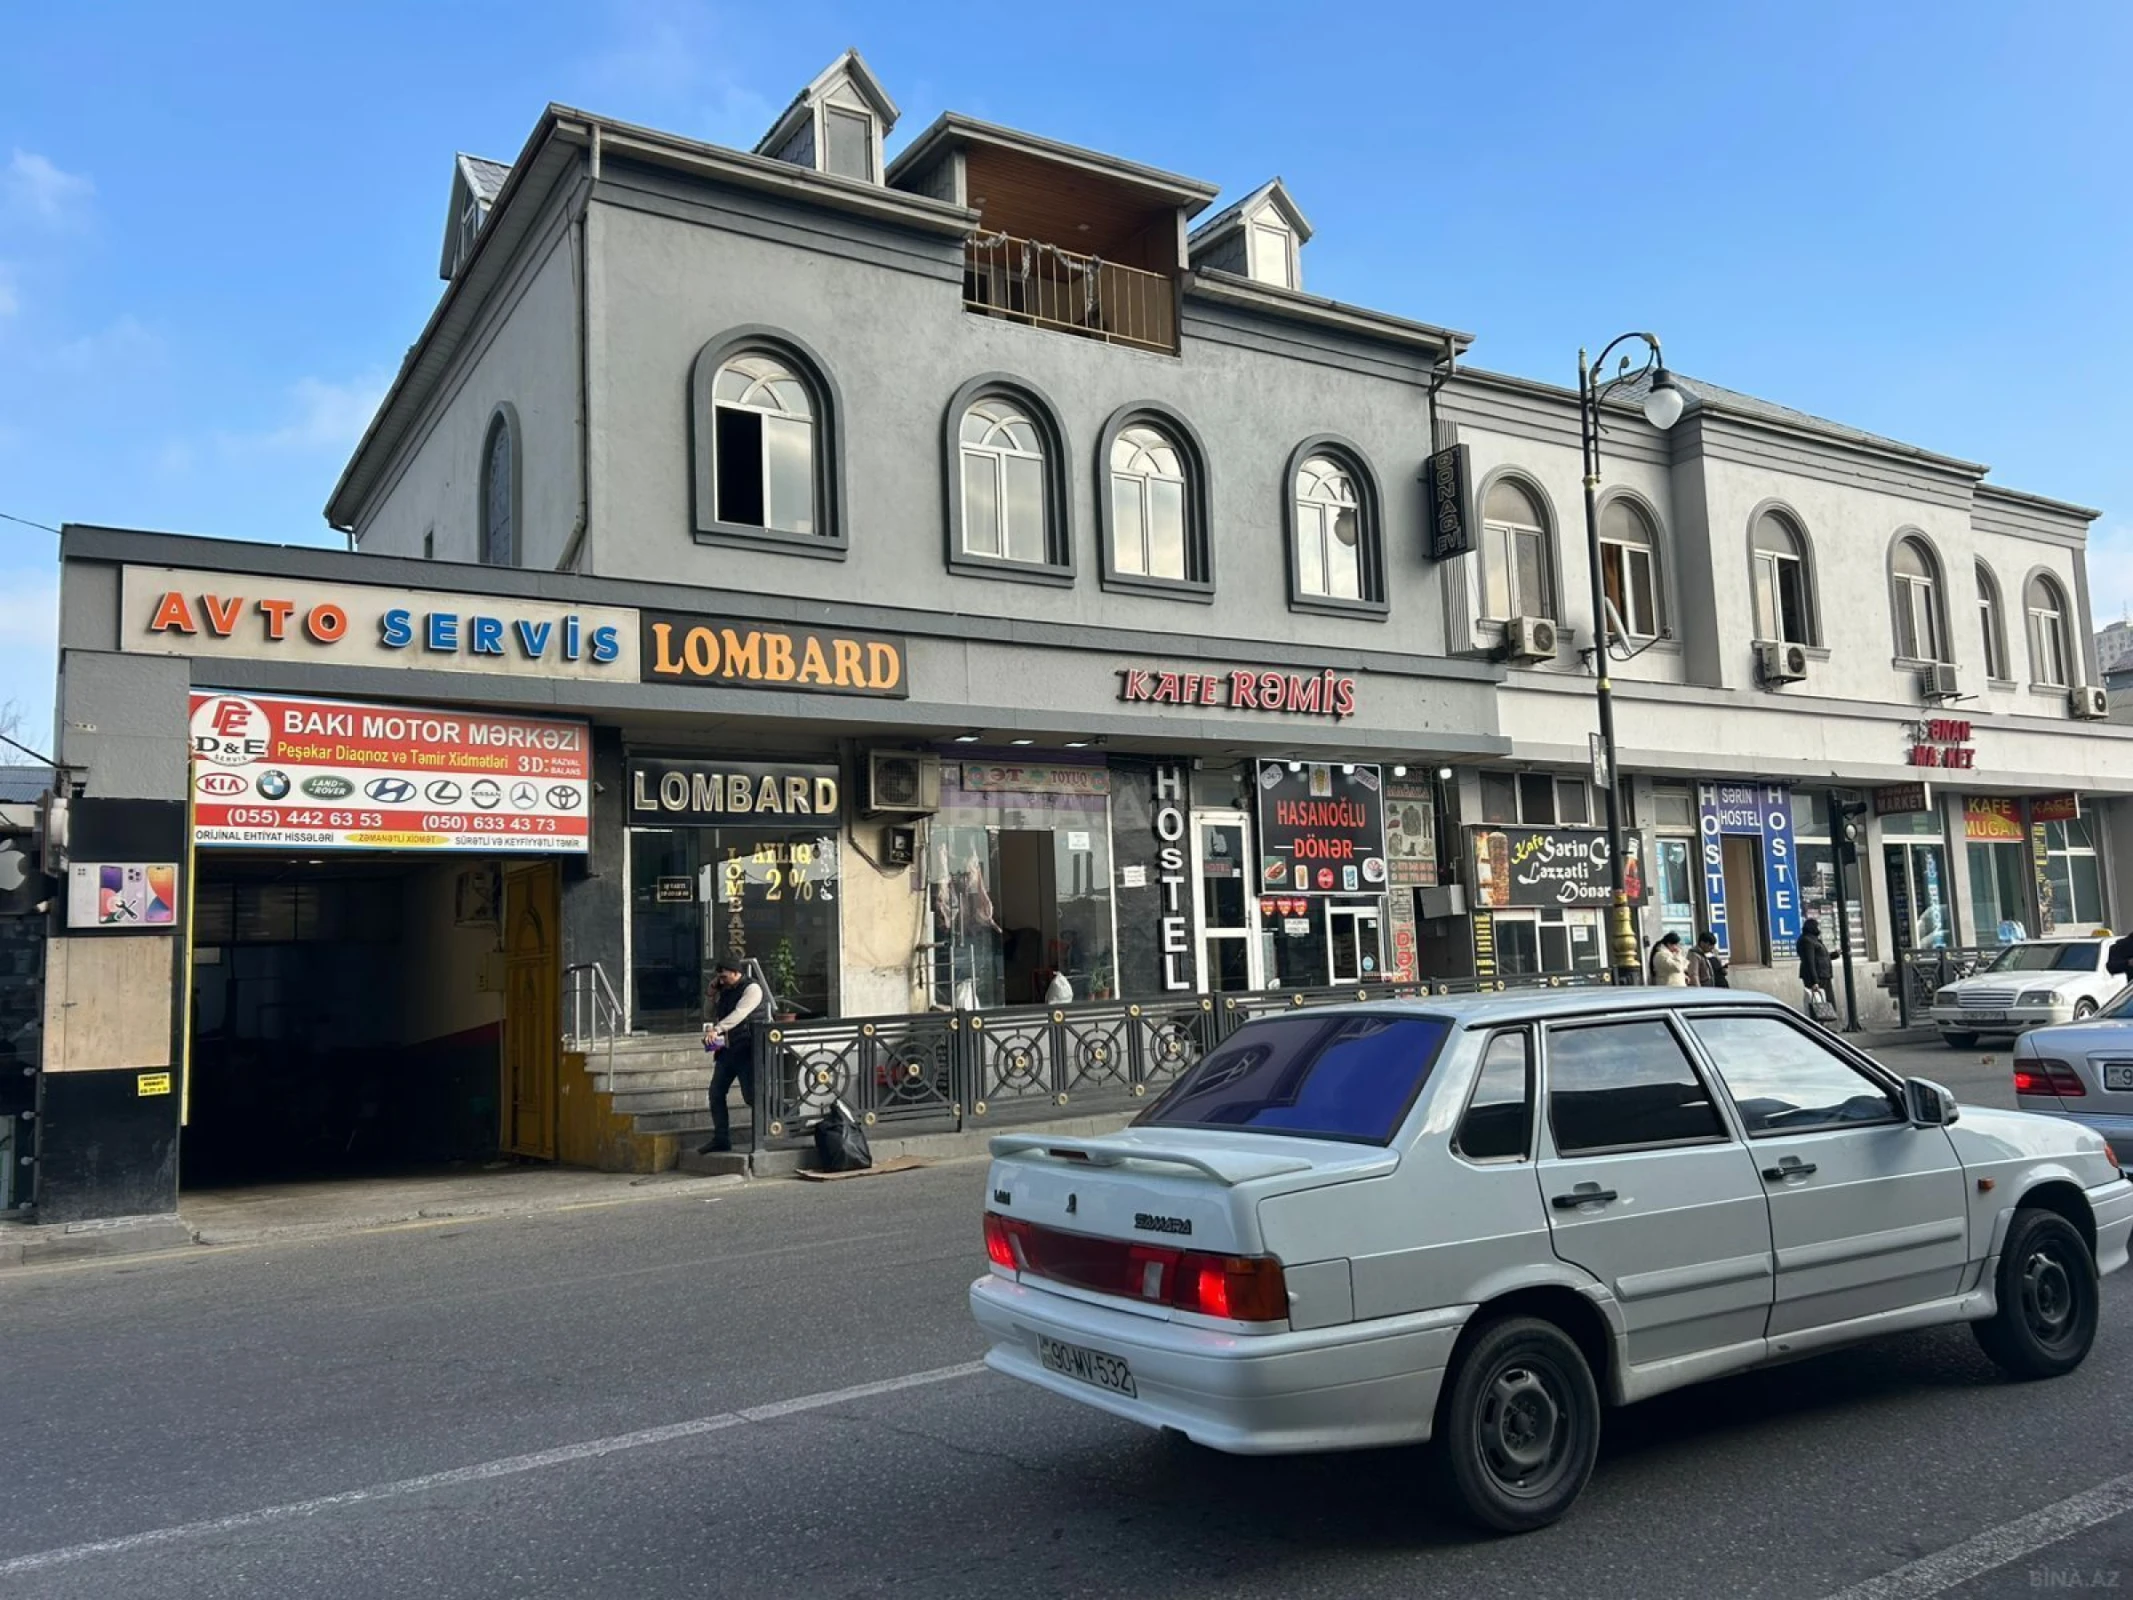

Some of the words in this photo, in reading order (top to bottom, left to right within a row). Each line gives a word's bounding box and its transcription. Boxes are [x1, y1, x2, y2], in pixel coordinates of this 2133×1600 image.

[151, 591, 347, 643] AVTO
[382, 609, 620, 663] SERVİS
[652, 623, 900, 690] LOMBARD
[1126, 668, 1217, 705] KAFE
[284, 710, 353, 737] BAKI
[363, 716, 461, 744] MOTOR
[469, 723, 580, 752] MƏRKƏZİ
[278, 741, 332, 761] Peşəkar
[335, 745, 388, 765] Diaqnoz
[392, 752, 407, 763] və
[410, 750, 445, 765] Təmir
[449, 751, 508, 769] Xidmətləri
[204, 778, 240, 791] KIA
[1052, 770, 1088, 783] TOYUQ
[633, 770, 838, 815] LOMBARD
[1721, 785, 1752, 804] SƏRİN
[1968, 798, 2012, 814] KAFE
[227, 808, 281, 827] (055)
[286, 810, 323, 825] 442
[330, 812, 353, 826] 63
[359, 813, 382, 827] 53
[422, 815, 468, 832] (050)
[473, 816, 504, 830] 633
[510, 818, 531, 831] 43
[536, 819, 556, 831] 73
[1277, 796, 1367, 828] HASANOĞLU
[1720, 810, 1760, 827] HOSTEL
[1294, 834, 1354, 859] DÖNƏR
[1511, 834, 1544, 865] Kafe
[1767, 786, 1794, 936] HOSTEL
[1156, 765, 1190, 991] HOSTEL
[1701, 786, 1728, 953] HOSTEL
[1135, 1212, 1192, 1235] SAMARA
